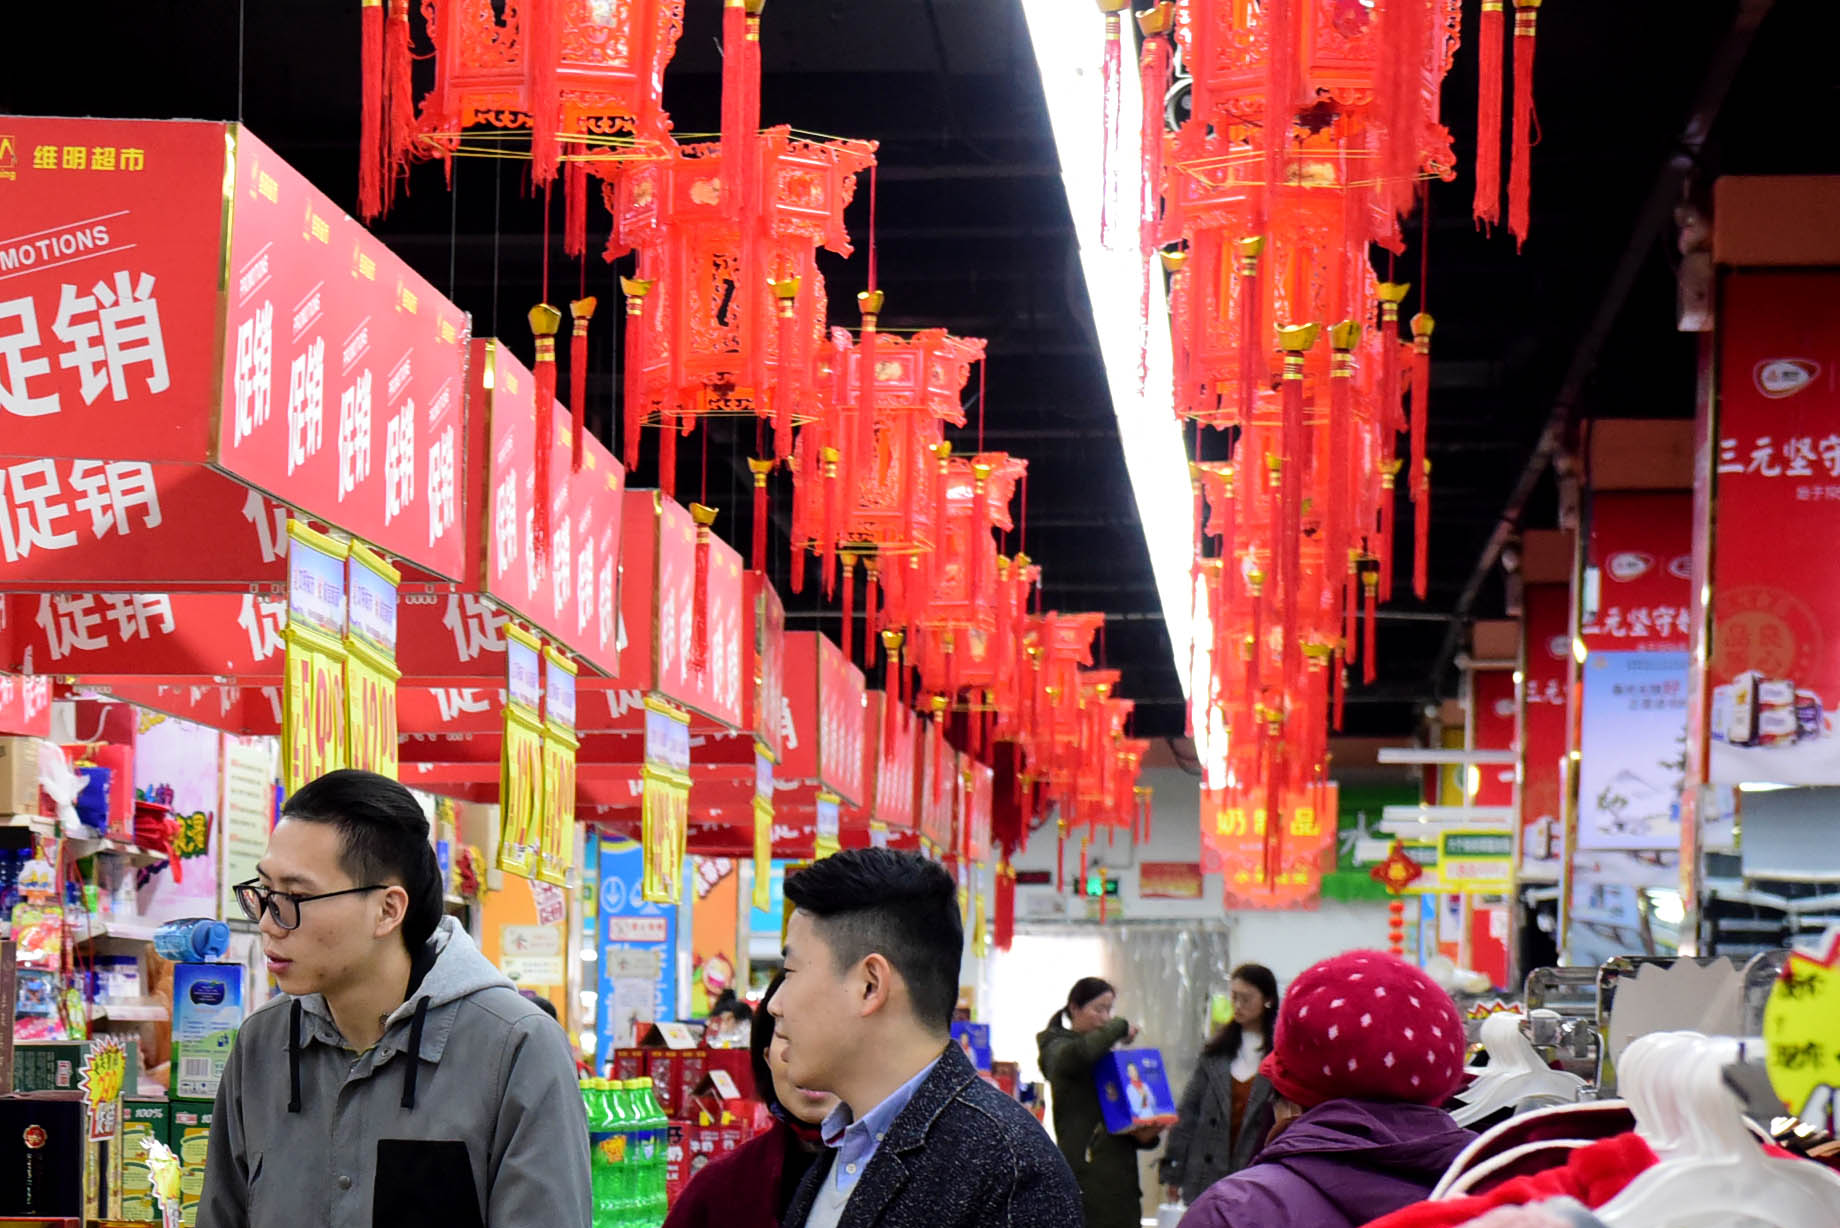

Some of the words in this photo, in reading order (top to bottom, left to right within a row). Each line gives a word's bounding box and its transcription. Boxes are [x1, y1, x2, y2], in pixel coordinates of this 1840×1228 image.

[33, 145, 145, 171] 维明超市
[234, 299, 272, 448] 促销
[288, 336, 324, 477] 促销
[338, 368, 372, 503] 促销
[384, 398, 415, 527] 促销
[428, 424, 455, 548] 促销
